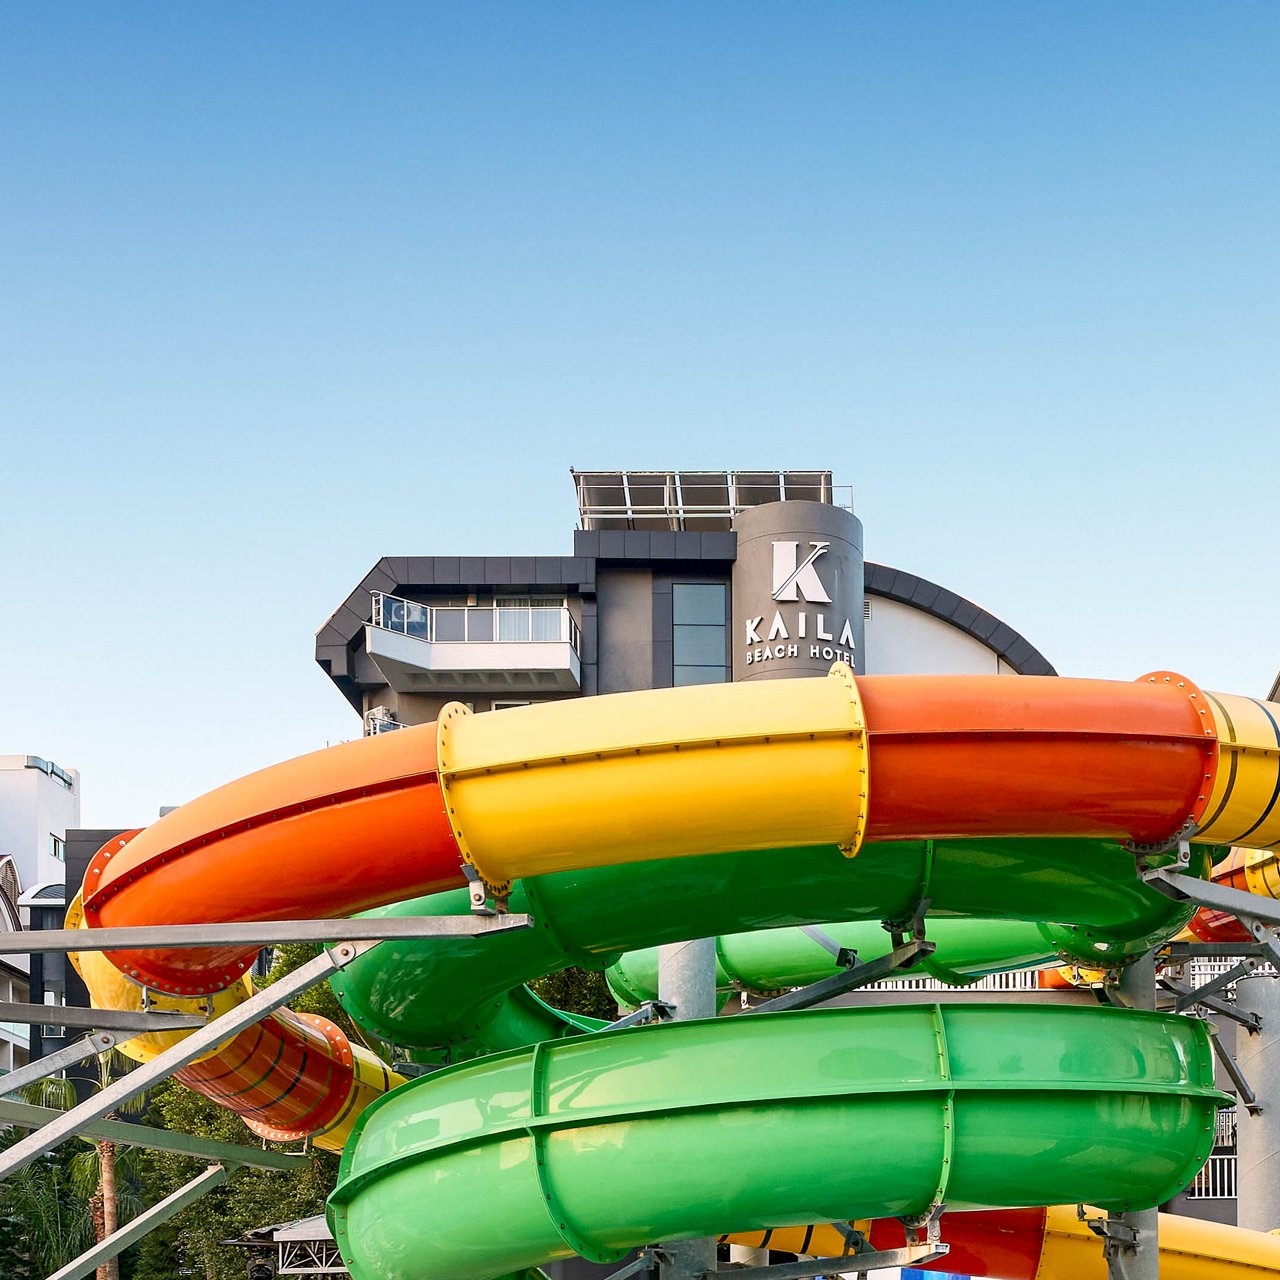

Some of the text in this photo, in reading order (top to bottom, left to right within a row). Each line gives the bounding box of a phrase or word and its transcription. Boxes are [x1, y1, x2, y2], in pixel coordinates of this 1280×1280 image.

[771, 541, 832, 603] K
[745, 609, 856, 649] KAILA
[746, 644, 856, 668] BEACH HOTEL
